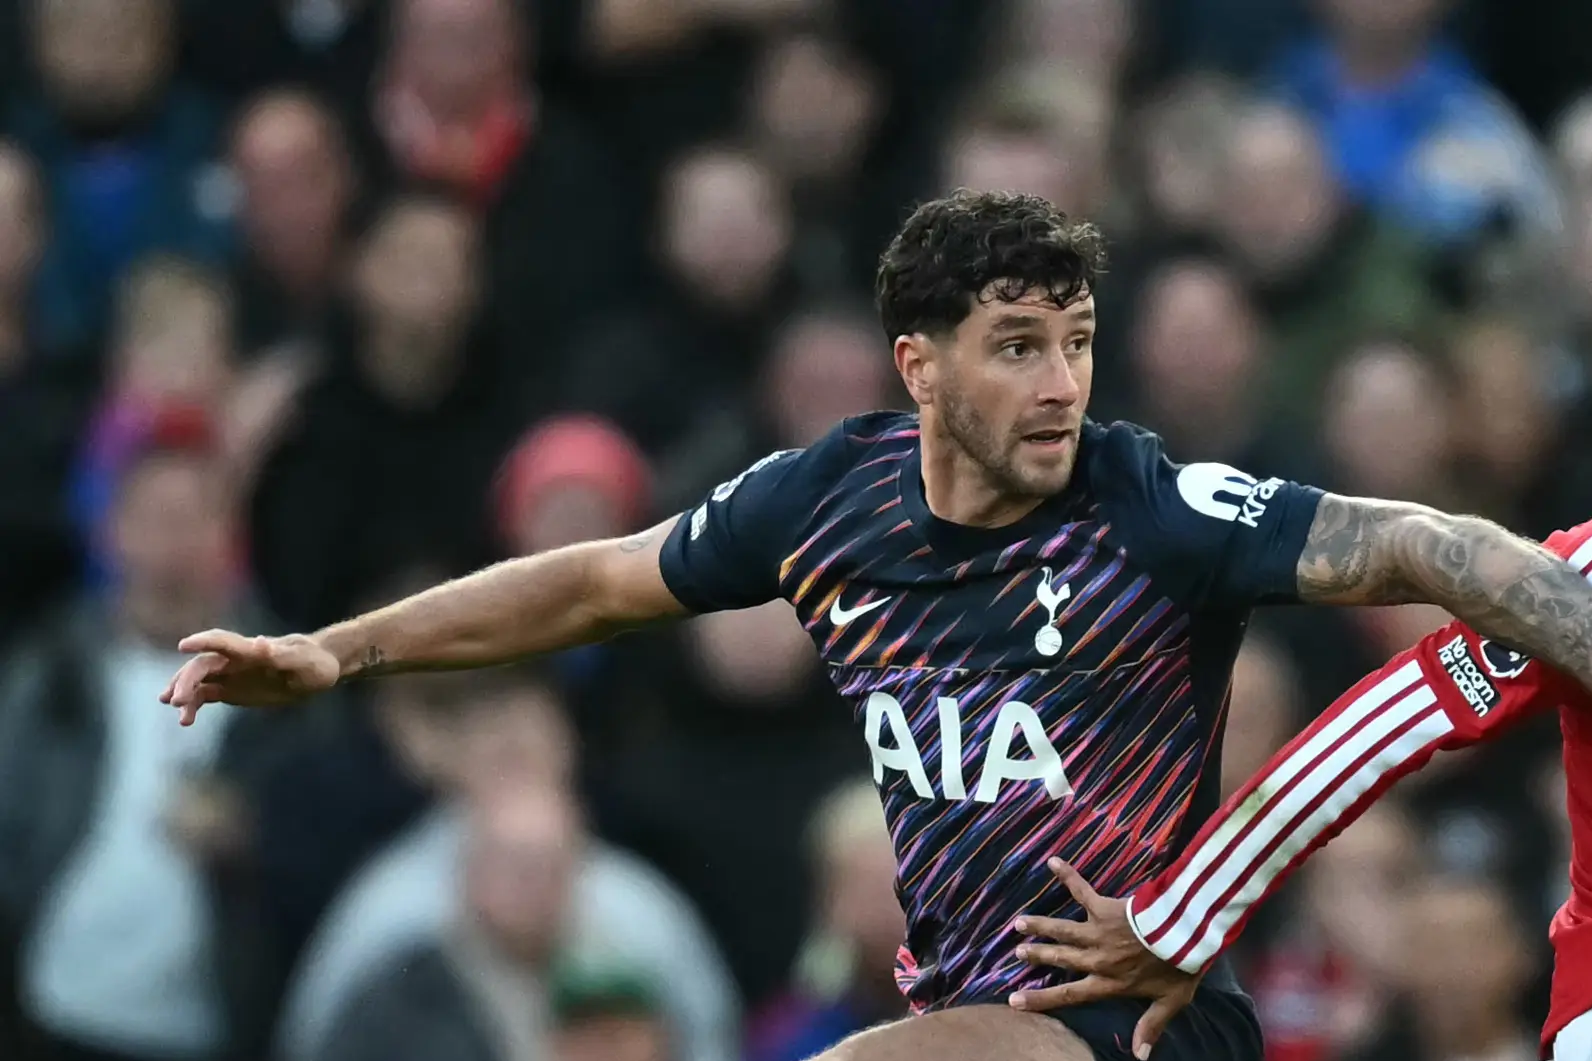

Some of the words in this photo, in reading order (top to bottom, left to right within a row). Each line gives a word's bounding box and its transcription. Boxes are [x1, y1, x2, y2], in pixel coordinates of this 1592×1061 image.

[1446, 634, 1467, 659] No
[1458, 655, 1495, 703] room
[1448, 663, 1489, 718] racism
[864, 691, 1075, 803] AIA
